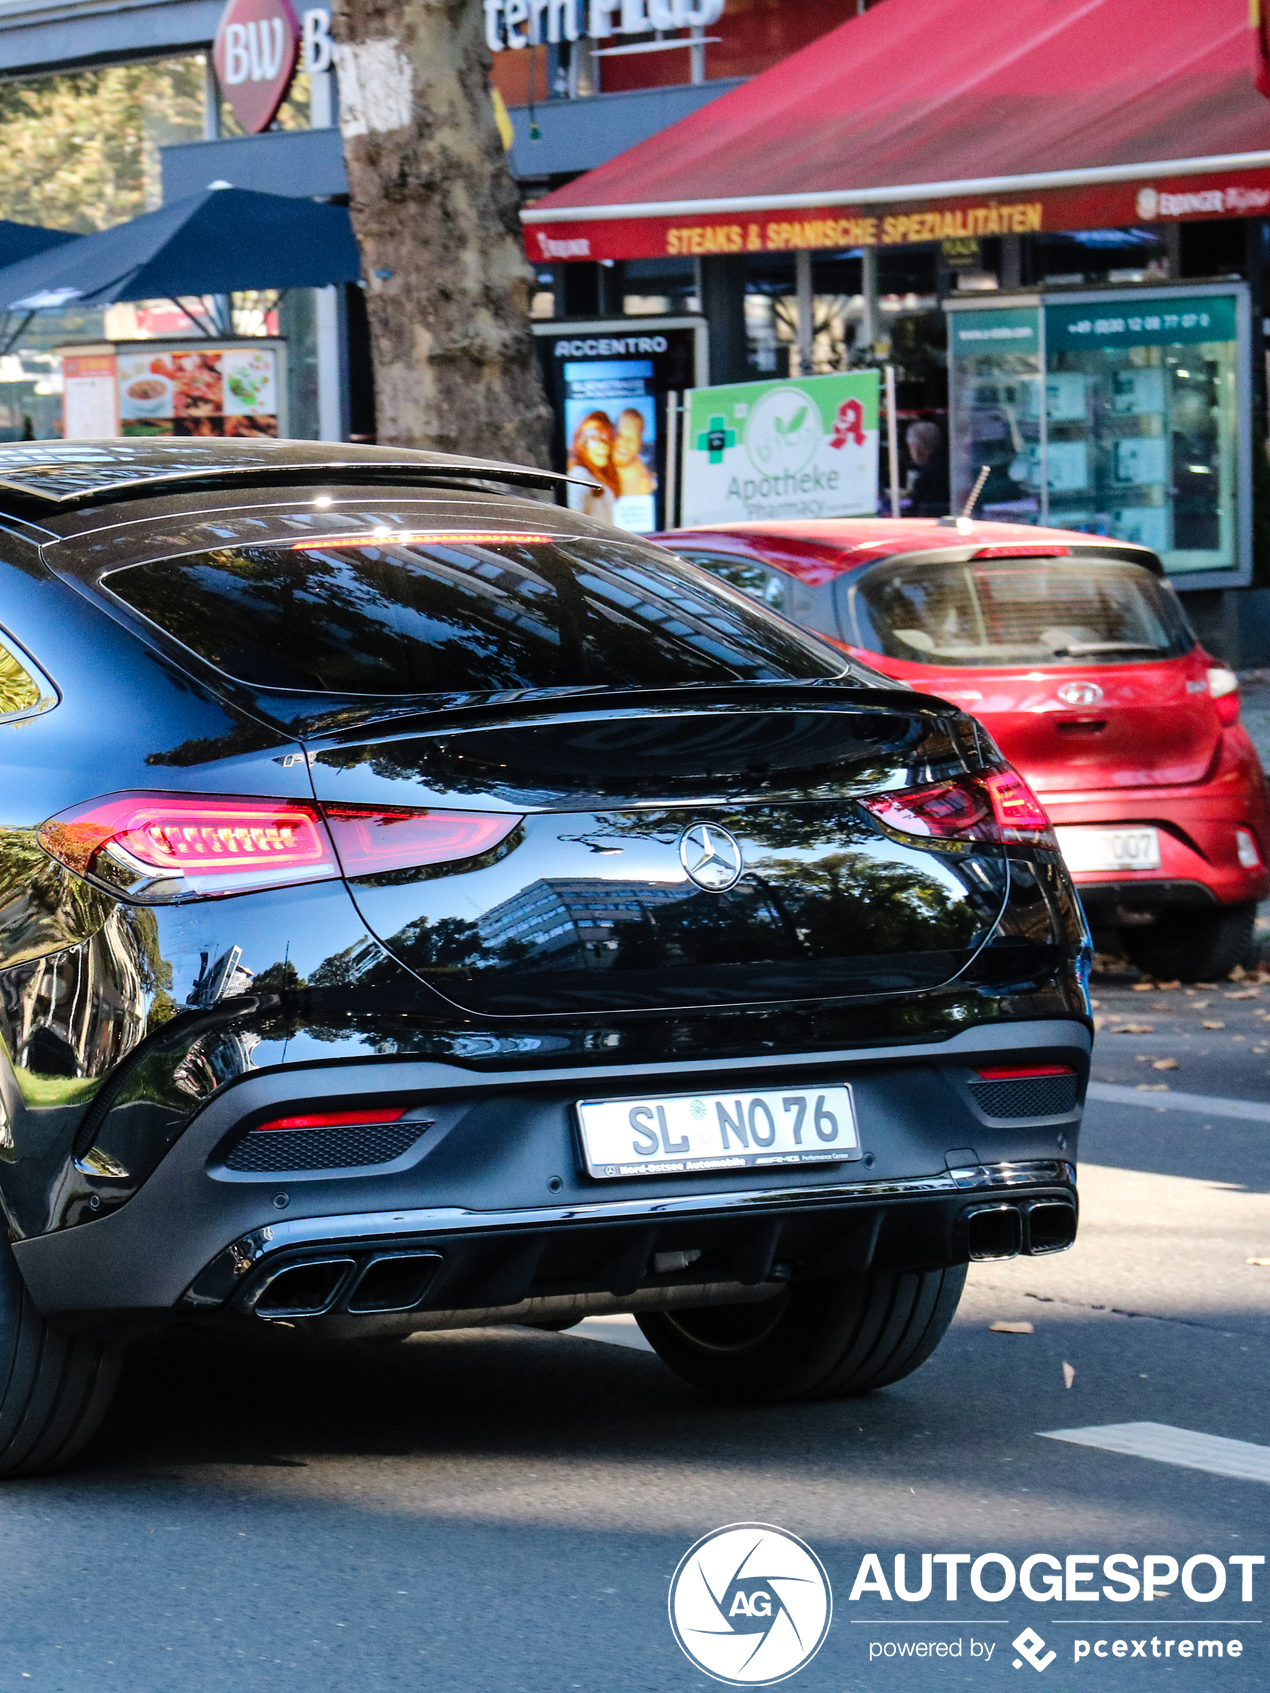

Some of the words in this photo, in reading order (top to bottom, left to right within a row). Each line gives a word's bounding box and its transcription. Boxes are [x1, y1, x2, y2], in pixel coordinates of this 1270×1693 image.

[226, 17, 285, 85] BW
[484, 0, 580, 51] tern
[666, 225, 744, 255] STEAKS
[746, 222, 763, 251] &
[766, 217, 878, 249] SPANISCHE
[881, 200, 1043, 245] SPEZIALITÄTEN
[553, 335, 668, 357] ACCENTRO
[725, 464, 840, 502] Apotheke
[628, 1105, 691, 1156] SL
[619, 1163, 684, 1175] Nord-Ostsee
[685, 1157, 746, 1170] Automobile
[764, 1155, 801, 1164] AMG
[801, 1154, 832, 1162] Performance
